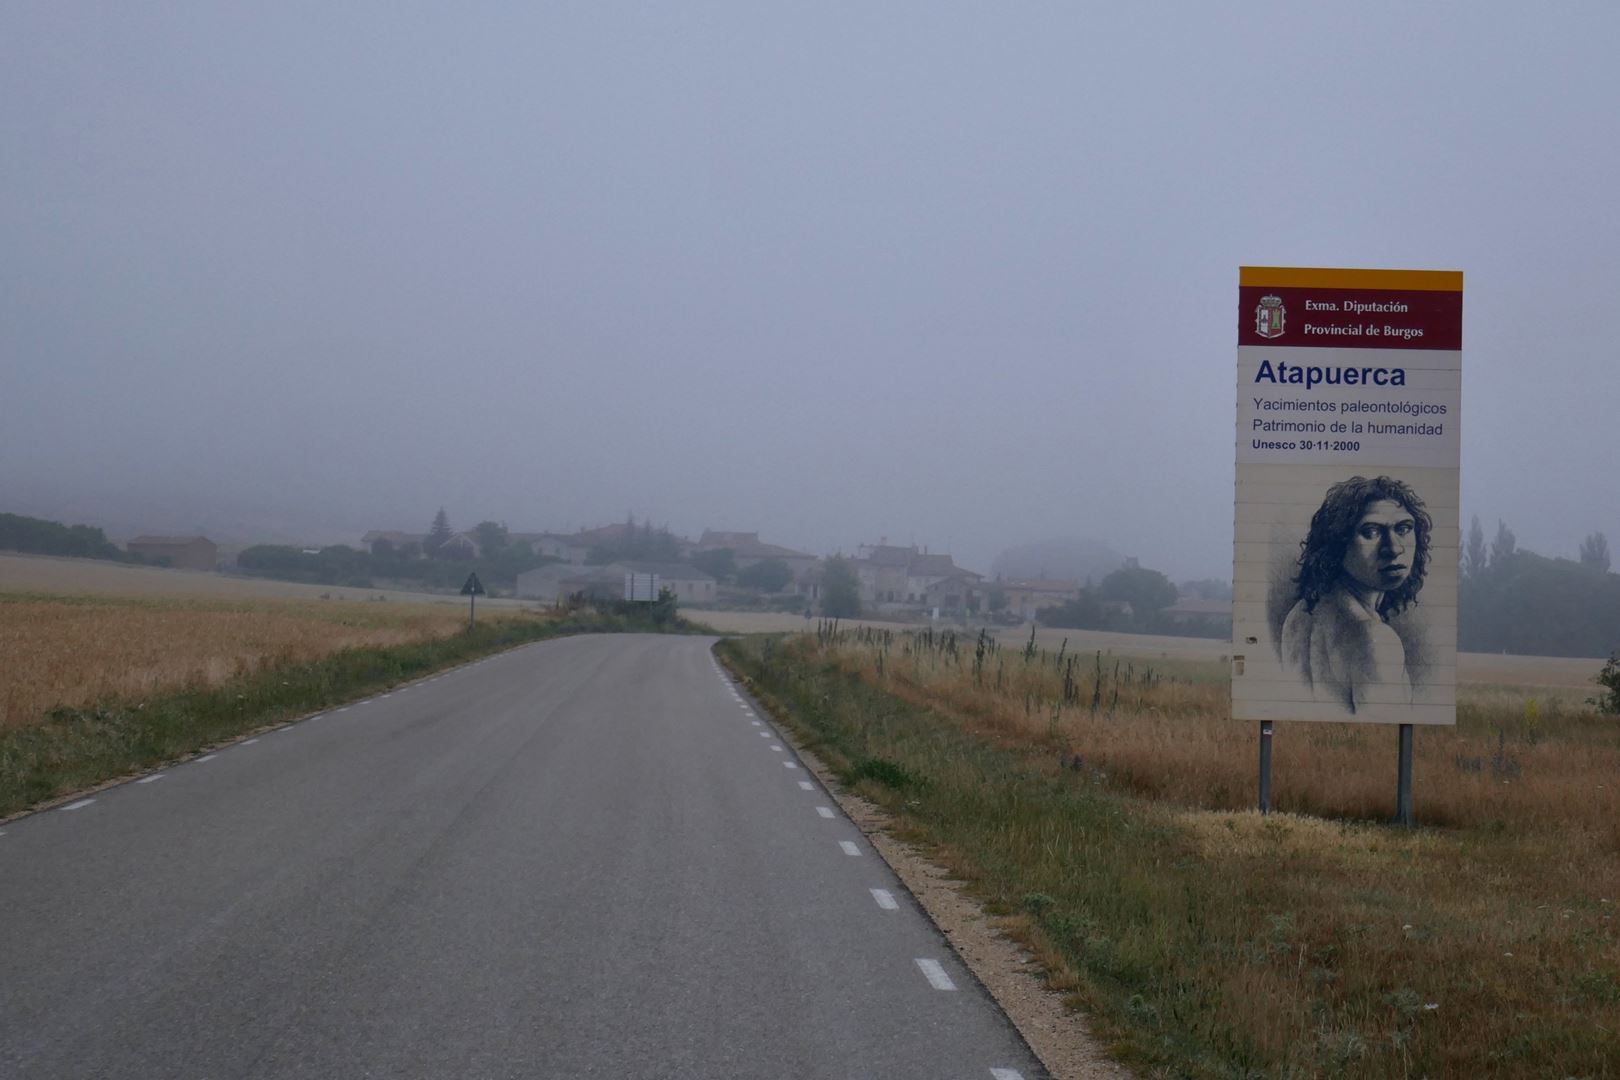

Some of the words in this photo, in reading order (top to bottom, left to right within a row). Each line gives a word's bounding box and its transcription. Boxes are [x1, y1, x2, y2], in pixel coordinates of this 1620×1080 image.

[1305, 300, 1339, 312] Exma.
[1344, 300, 1408, 315] Diputación
[1304, 324, 1362, 336] Provincial
[1366, 325, 1380, 336] de
[1384, 325, 1424, 339] Burgos
[1254, 360, 1406, 390] Atapuerca
[1253, 398, 1336, 411] Yacimientos
[1341, 400, 1447, 417] paleontológicos
[1253, 419, 1326, 433] Patrimonio
[1330, 421, 1346, 433] de
[1351, 421, 1363, 434] la
[1368, 422, 1443, 435] humanidad
[1252, 440, 1296, 450] Unesco
